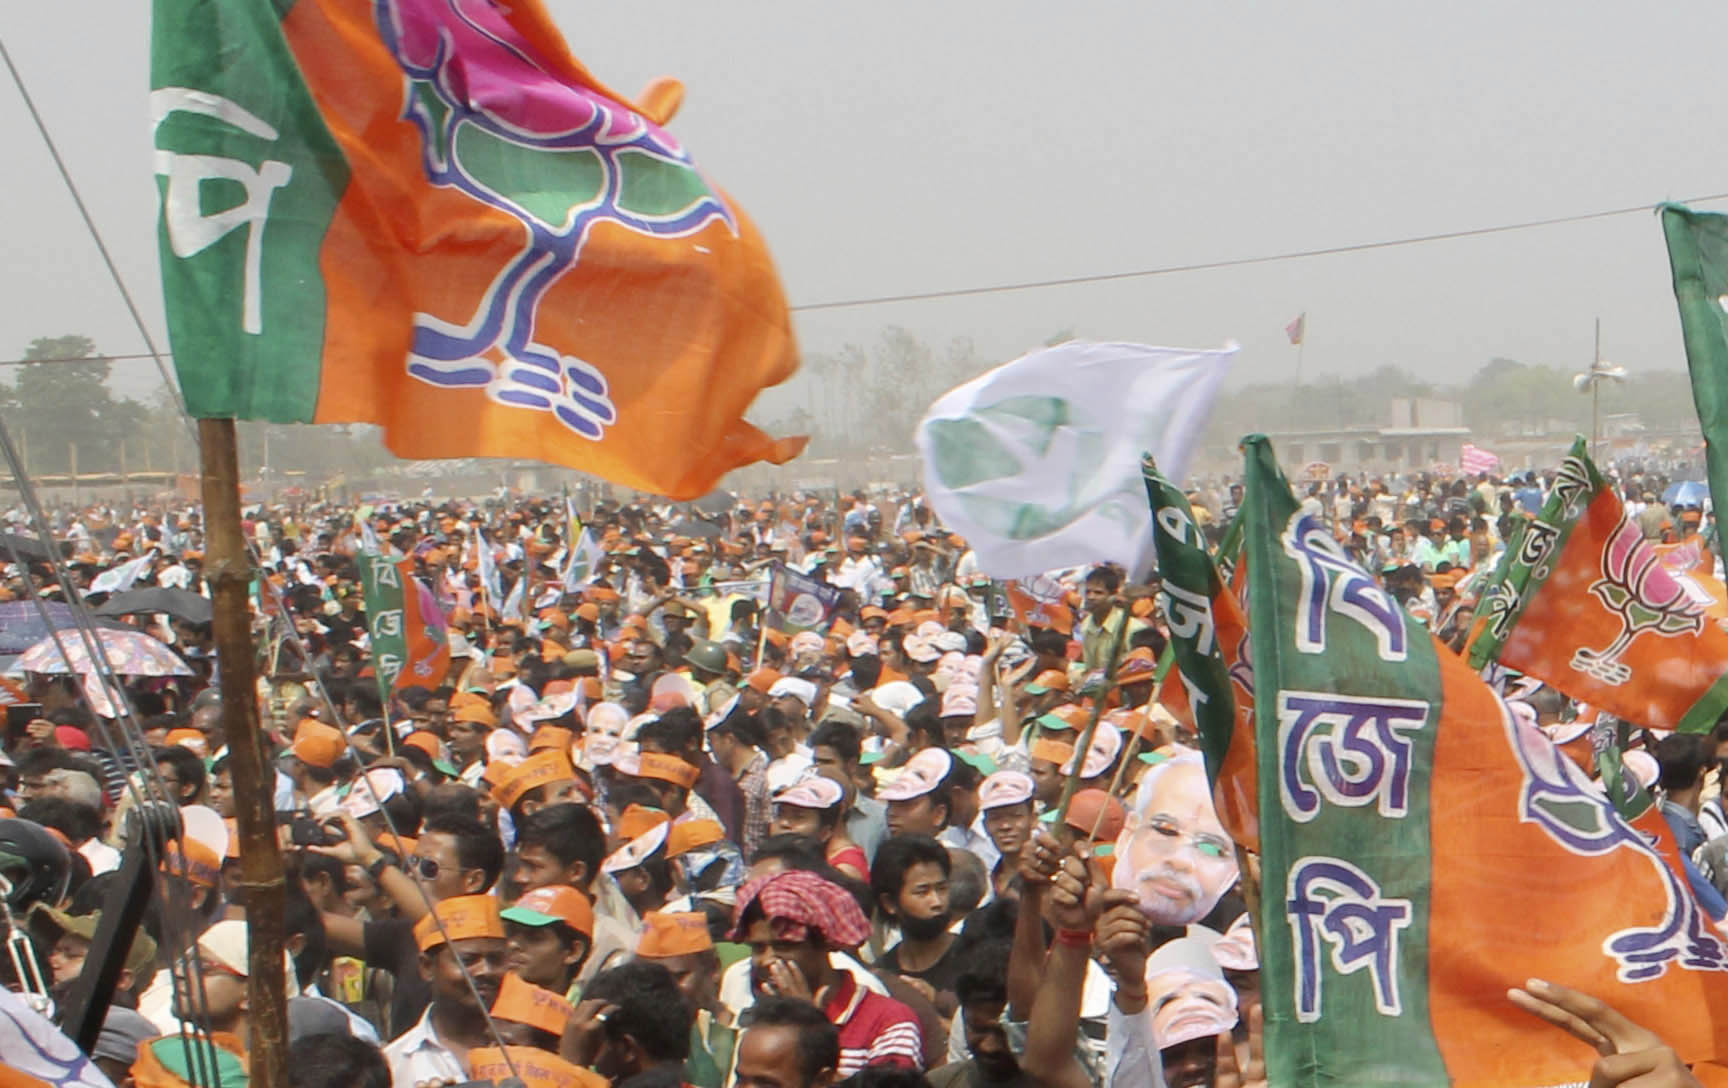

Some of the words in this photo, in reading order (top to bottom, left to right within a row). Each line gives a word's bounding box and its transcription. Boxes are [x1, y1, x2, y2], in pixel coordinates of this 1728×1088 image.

[1281, 508, 1408, 662] বি
[1278, 690, 1431, 823] জে
[1286, 855, 1413, 1024] পি
